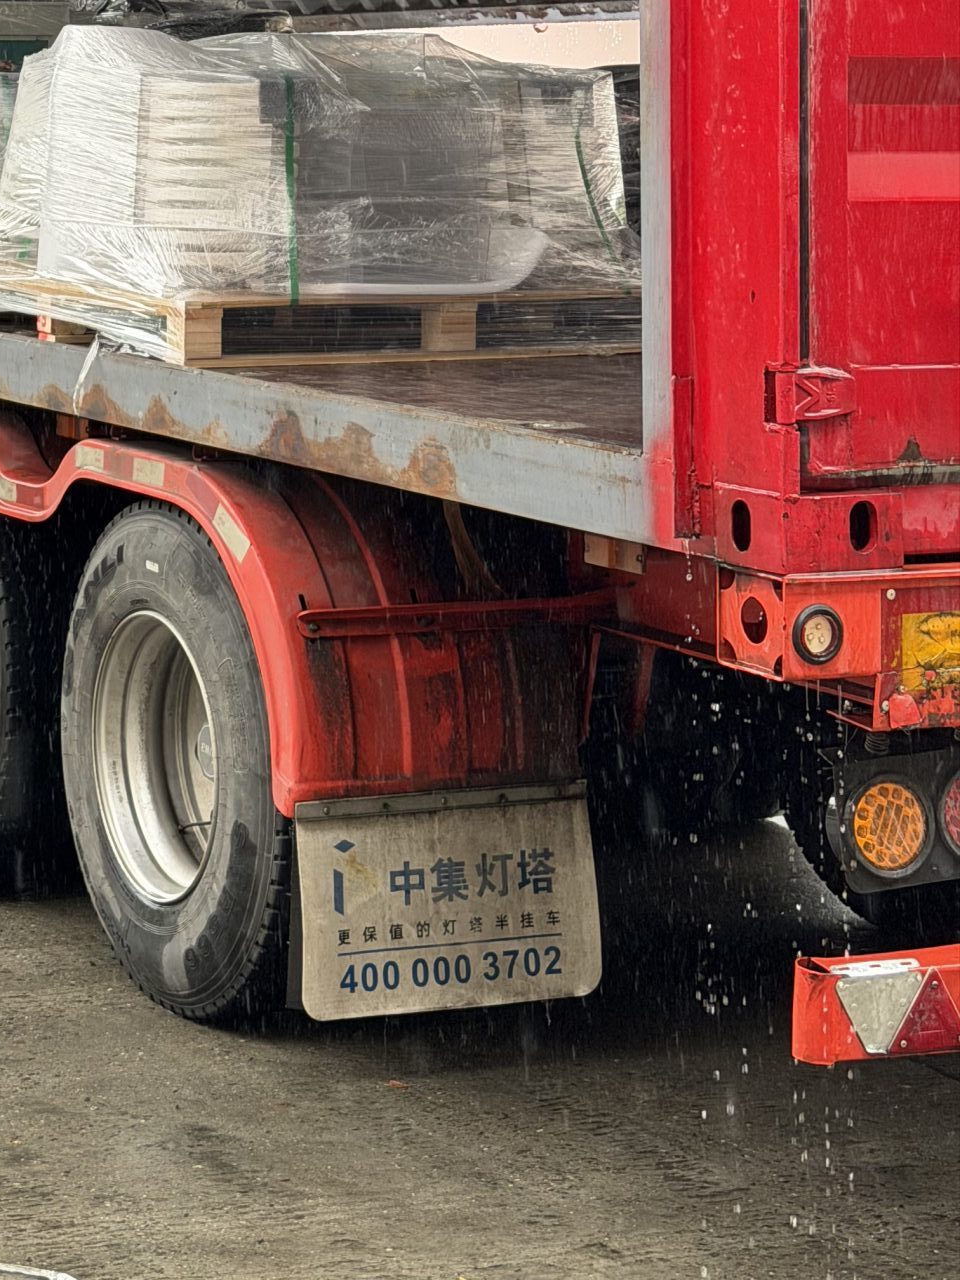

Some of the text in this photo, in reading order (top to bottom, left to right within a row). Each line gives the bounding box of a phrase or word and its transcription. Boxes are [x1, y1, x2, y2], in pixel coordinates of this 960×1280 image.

[390, 847, 556, 907] 中集灯塔
[340, 945, 562, 994] 400 000 3702
